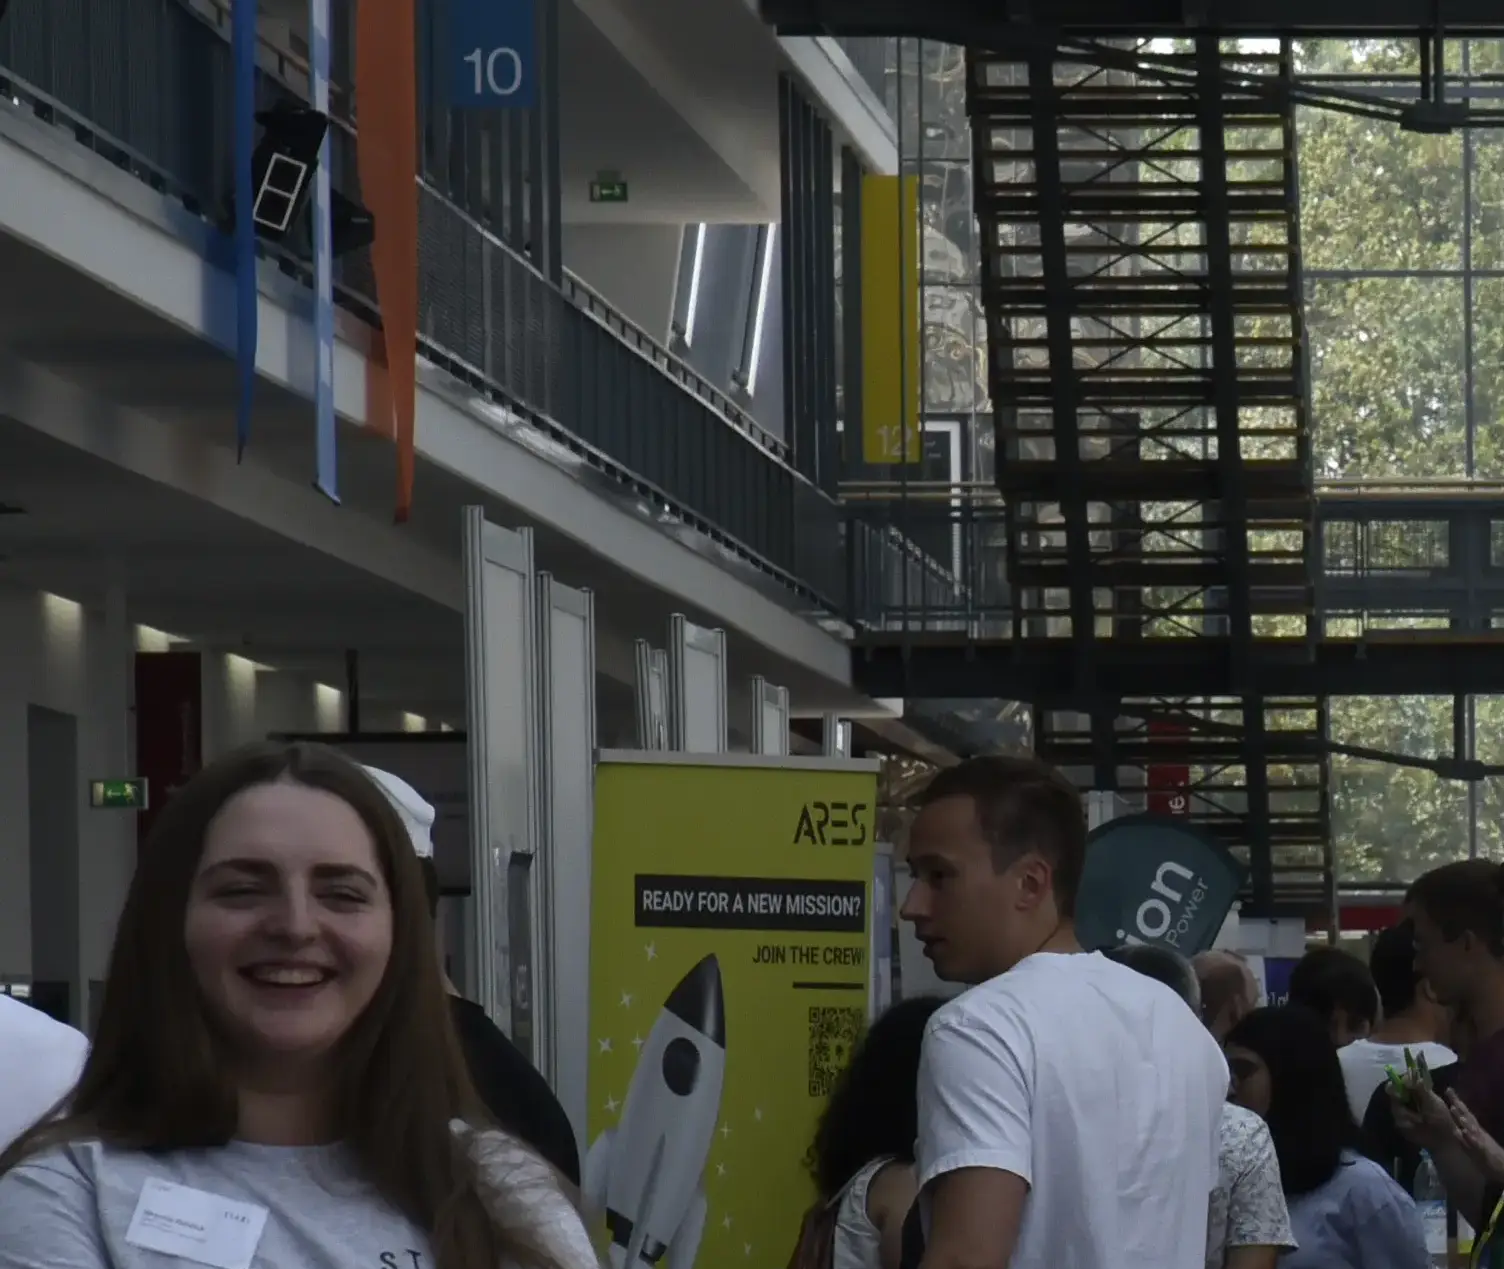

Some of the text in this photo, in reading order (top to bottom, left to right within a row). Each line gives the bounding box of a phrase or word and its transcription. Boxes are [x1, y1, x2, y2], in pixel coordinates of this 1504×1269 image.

[463, 47, 522, 95] 10
[794, 802, 867, 845] ARES
[642, 889, 861, 916] READY FOR A NEW MISSION?
[1165, 877, 1208, 948] Power
[752, 945, 786, 964] JOIN
[791, 946, 819, 965] THE
